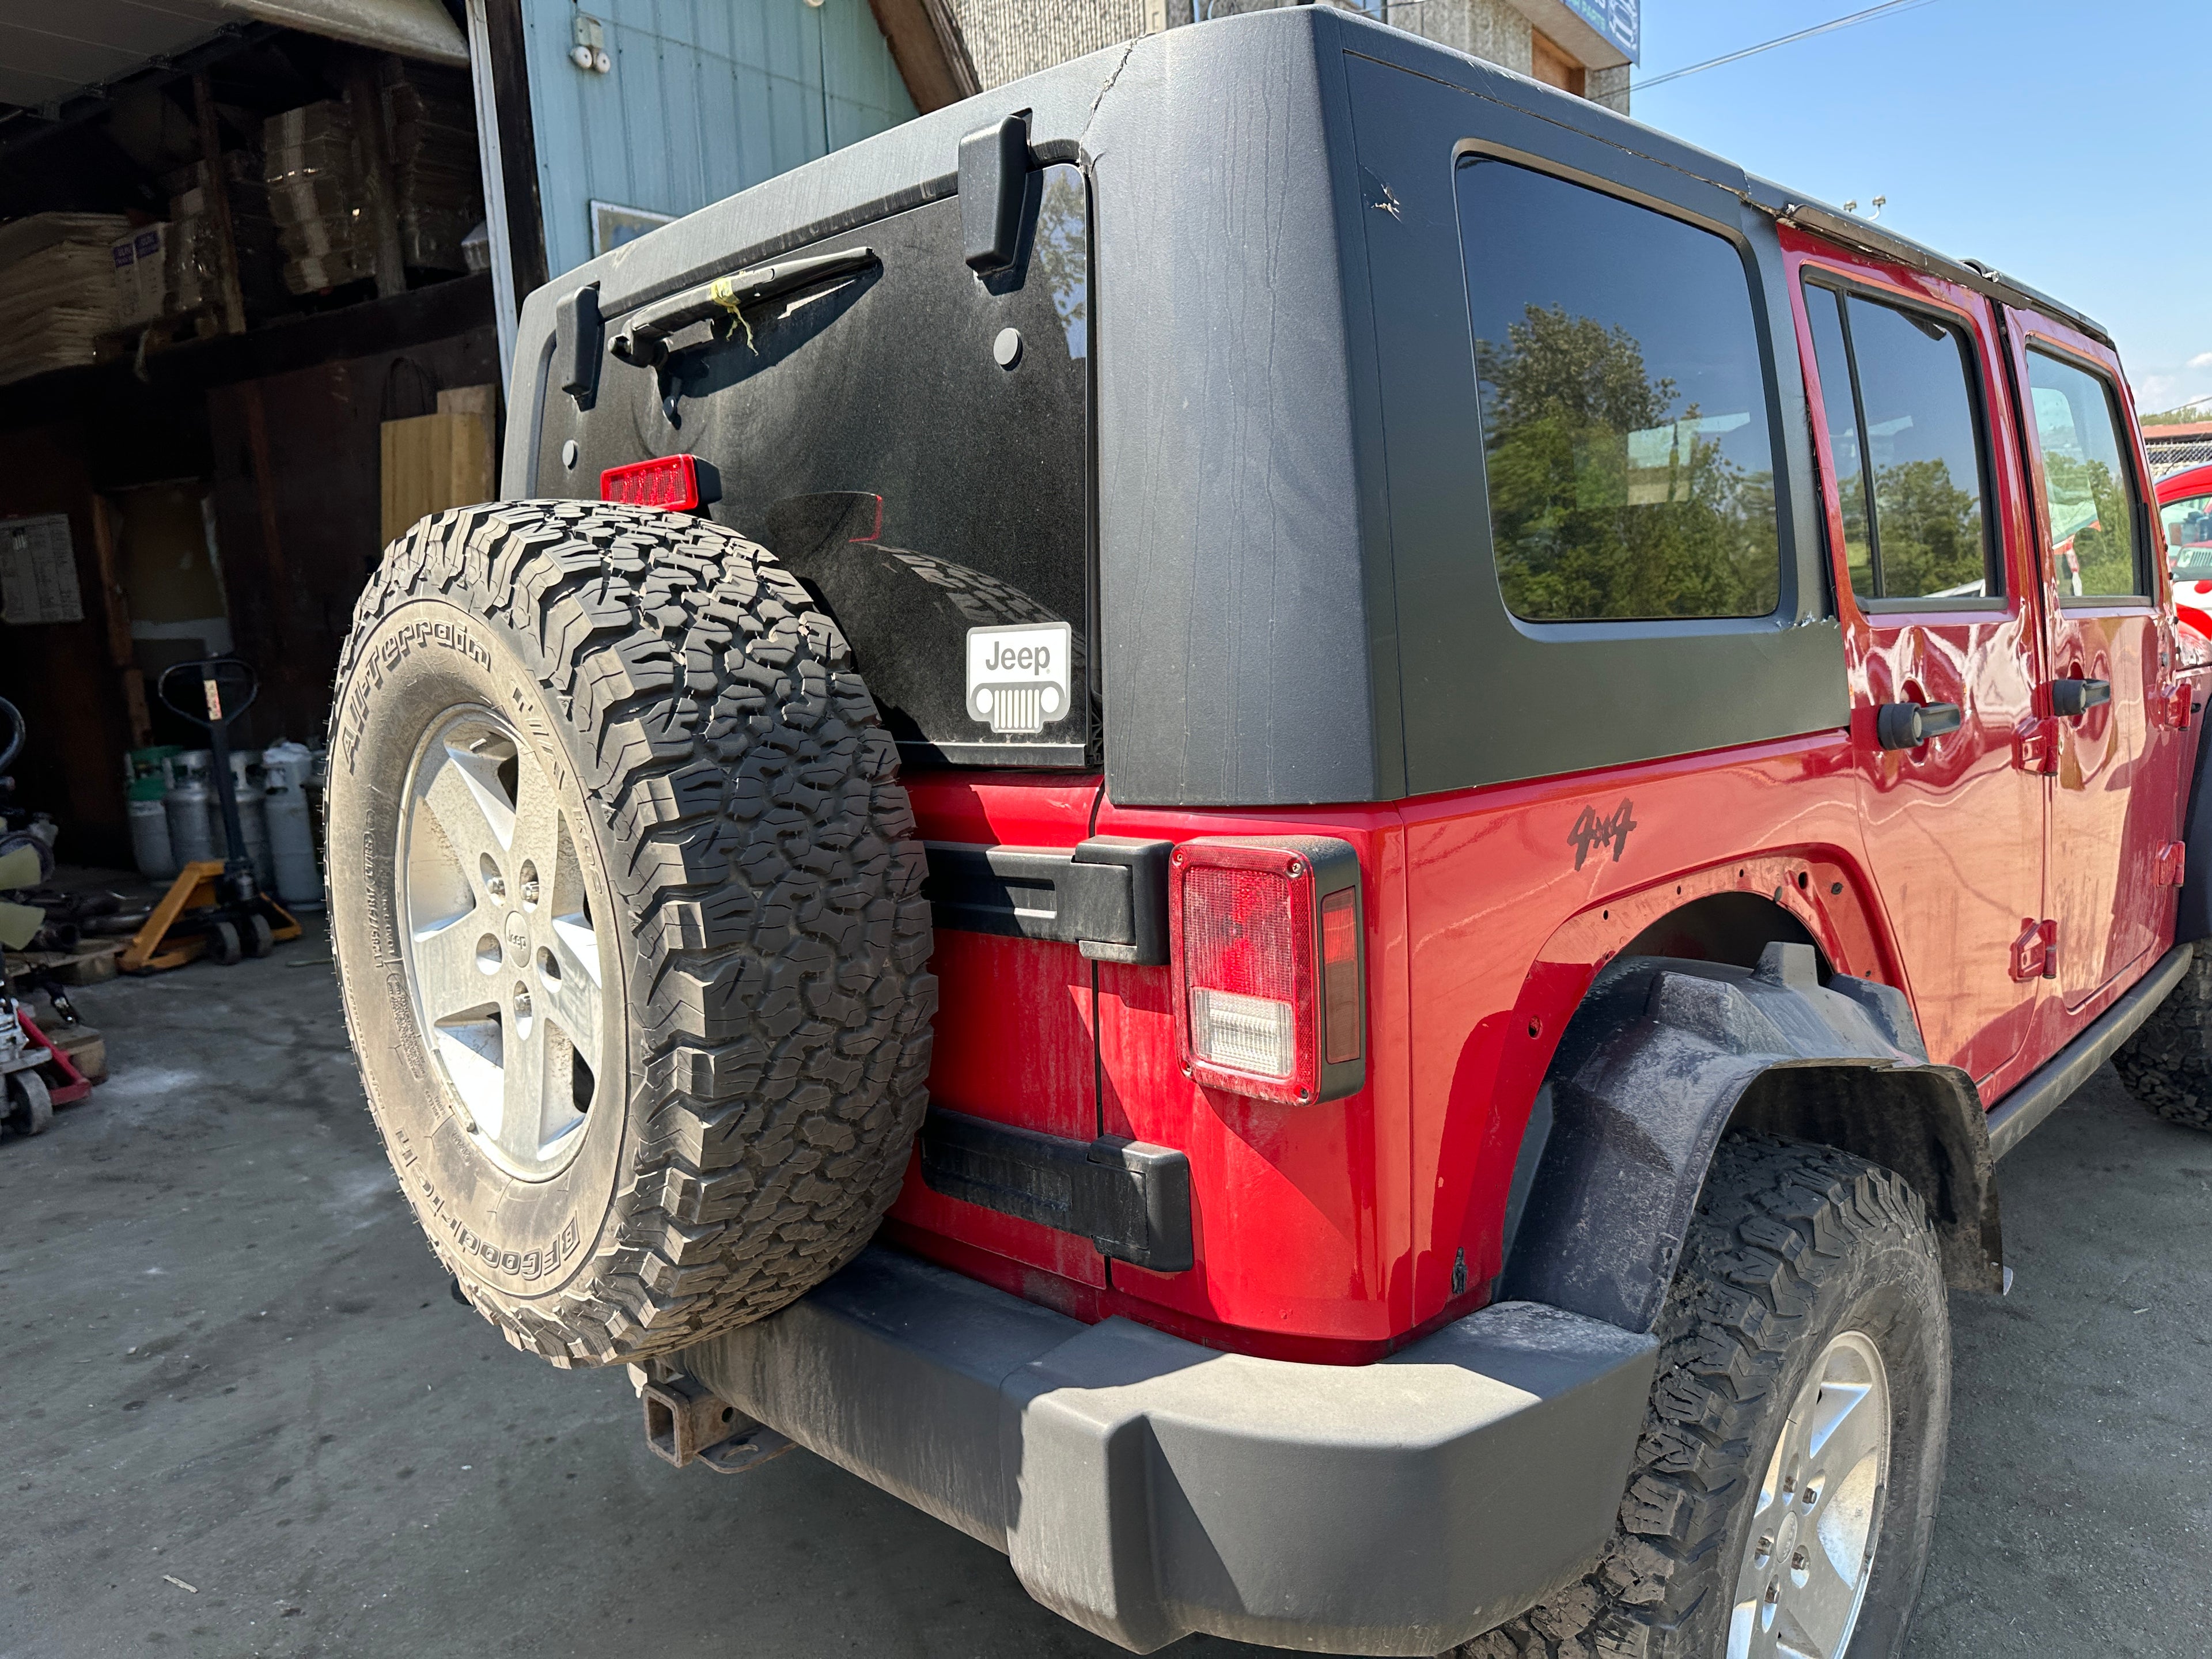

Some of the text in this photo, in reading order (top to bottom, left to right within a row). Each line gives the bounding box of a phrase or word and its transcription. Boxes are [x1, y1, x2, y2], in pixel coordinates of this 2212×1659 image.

[986, 641, 1051, 676] Jeep
[1566, 797, 1637, 872] 4x4
[507, 929, 527, 952] Jeep
